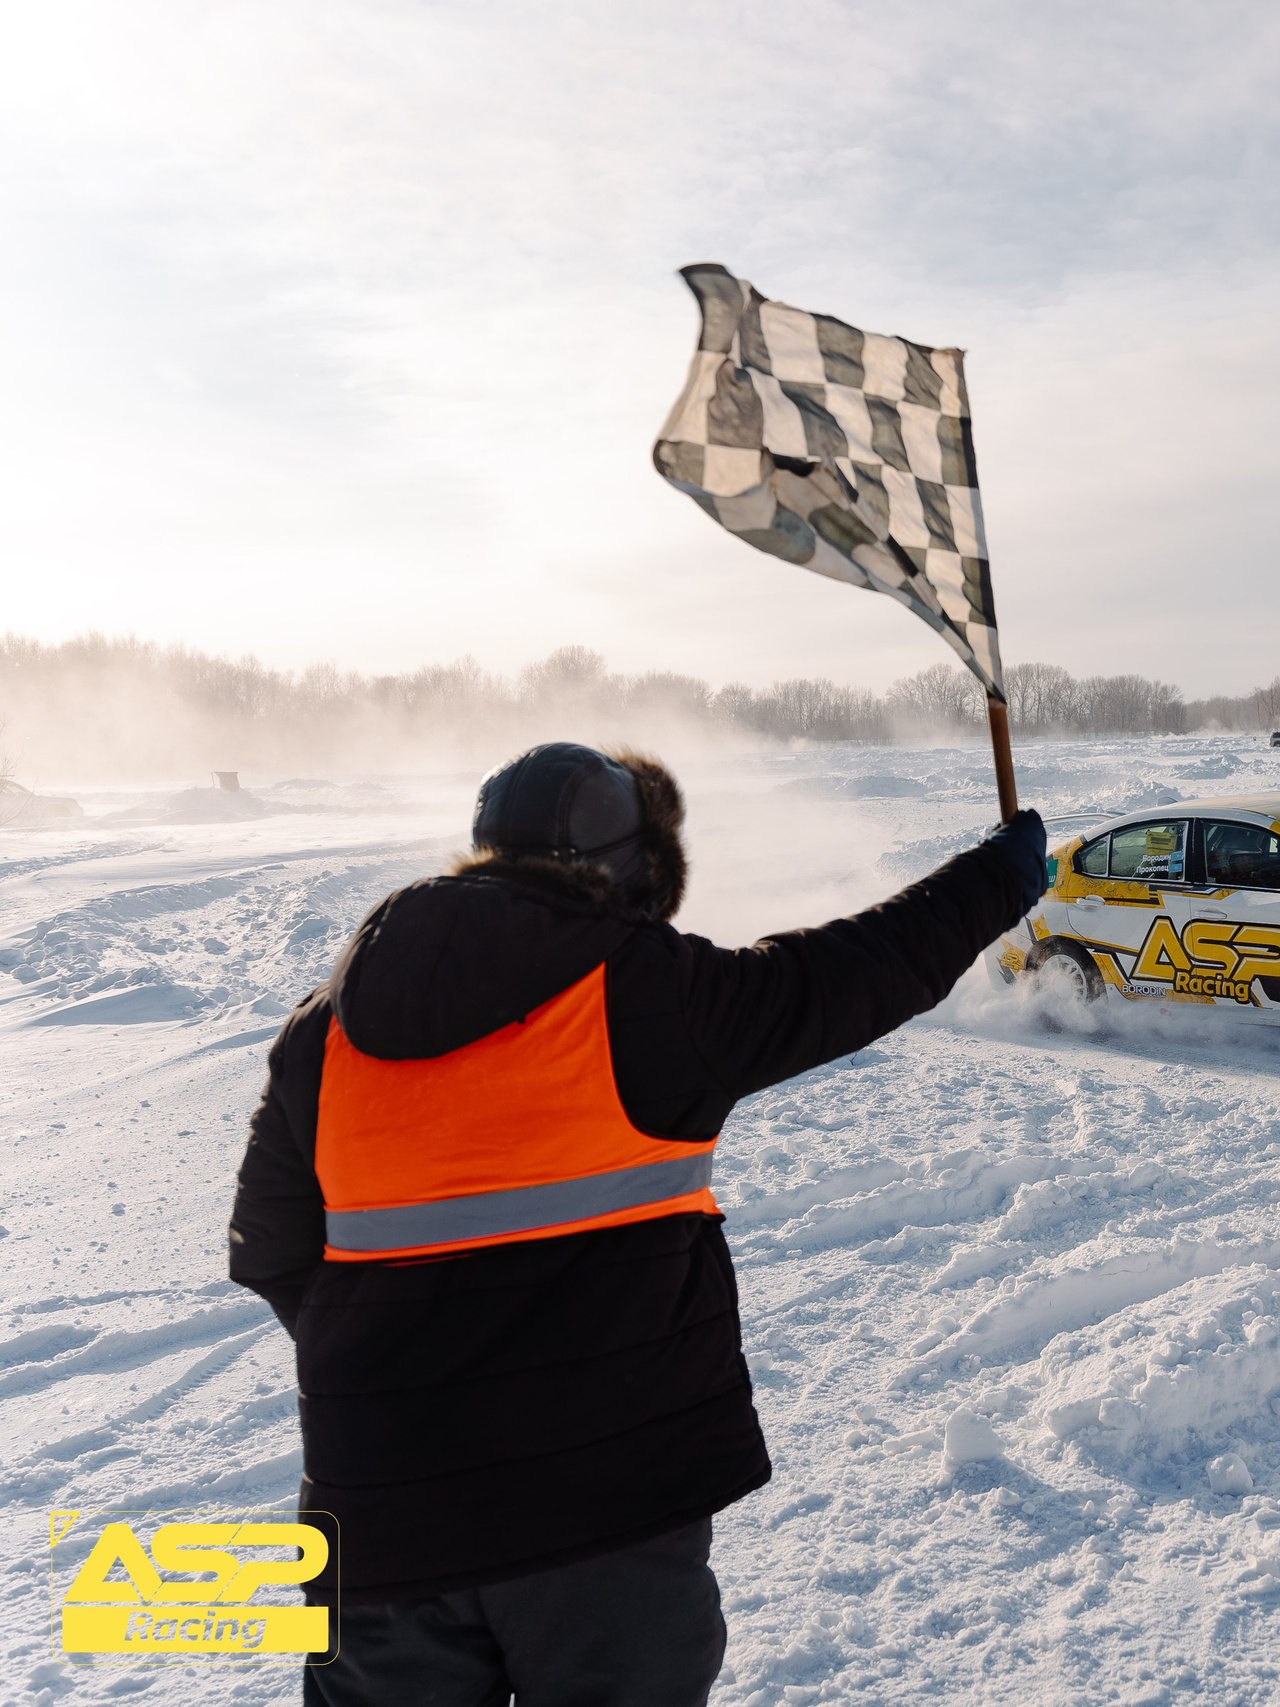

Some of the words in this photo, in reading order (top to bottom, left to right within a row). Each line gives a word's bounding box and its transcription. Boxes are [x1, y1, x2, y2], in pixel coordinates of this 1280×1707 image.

[1142, 854, 1171, 862] Бородин
[1136, 864, 1169, 874] Прокопец
[1122, 984, 1166, 996] BORODIN
[1174, 971, 1250, 1002] Racing
